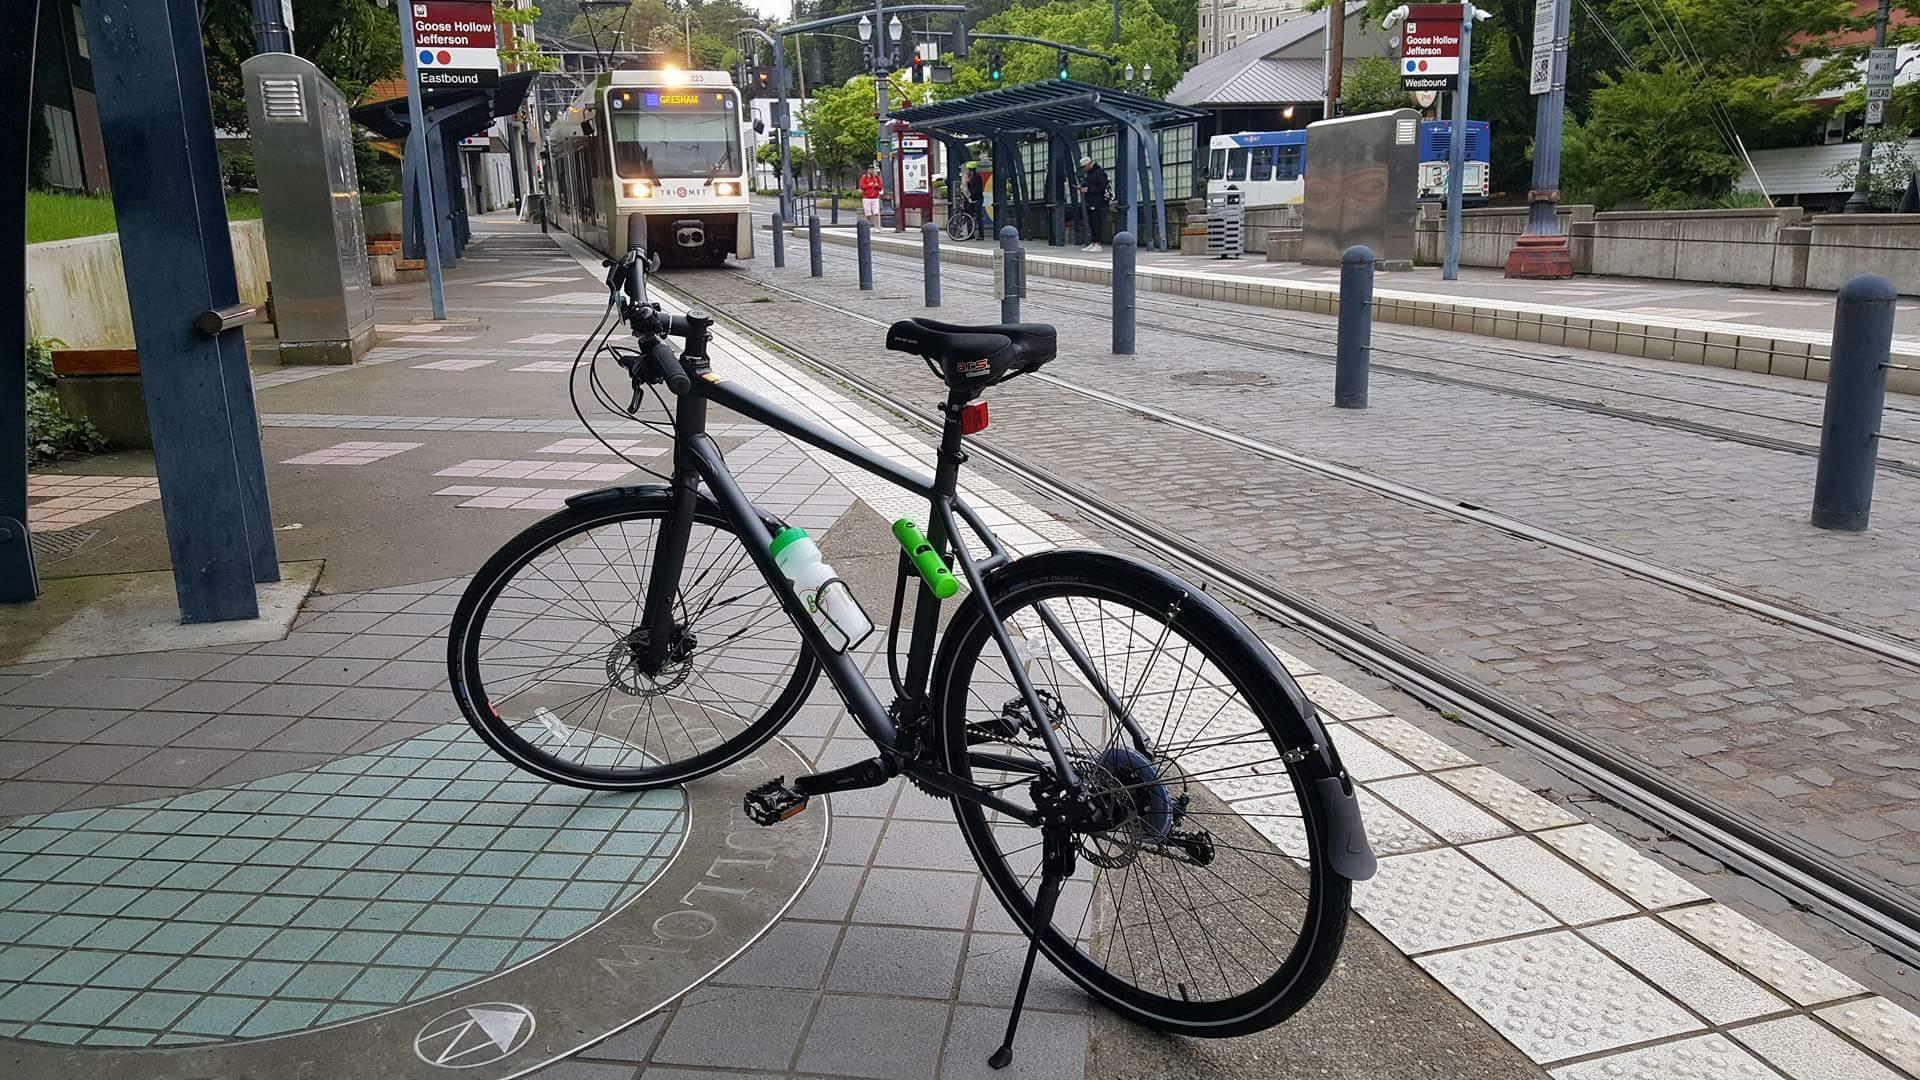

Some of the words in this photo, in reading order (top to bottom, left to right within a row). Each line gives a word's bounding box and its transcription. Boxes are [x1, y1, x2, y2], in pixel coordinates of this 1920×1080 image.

[416, 21, 451, 31] Goose
[454, 21, 491, 32] Hollow
[417, 34, 468, 44] Jefferson
[1406, 36, 1431, 44] Goose
[1433, 36, 1458, 44] Hollow
[1406, 46, 1441, 55] Jefferson
[1875, 62, 1889, 70] MUST
[420, 73, 478, 84] Eastbound
[1405, 78, 1447, 87] Westbound
[1869, 88, 1889, 97] AHEAD
[660, 95, 699, 104] GRESHAM
